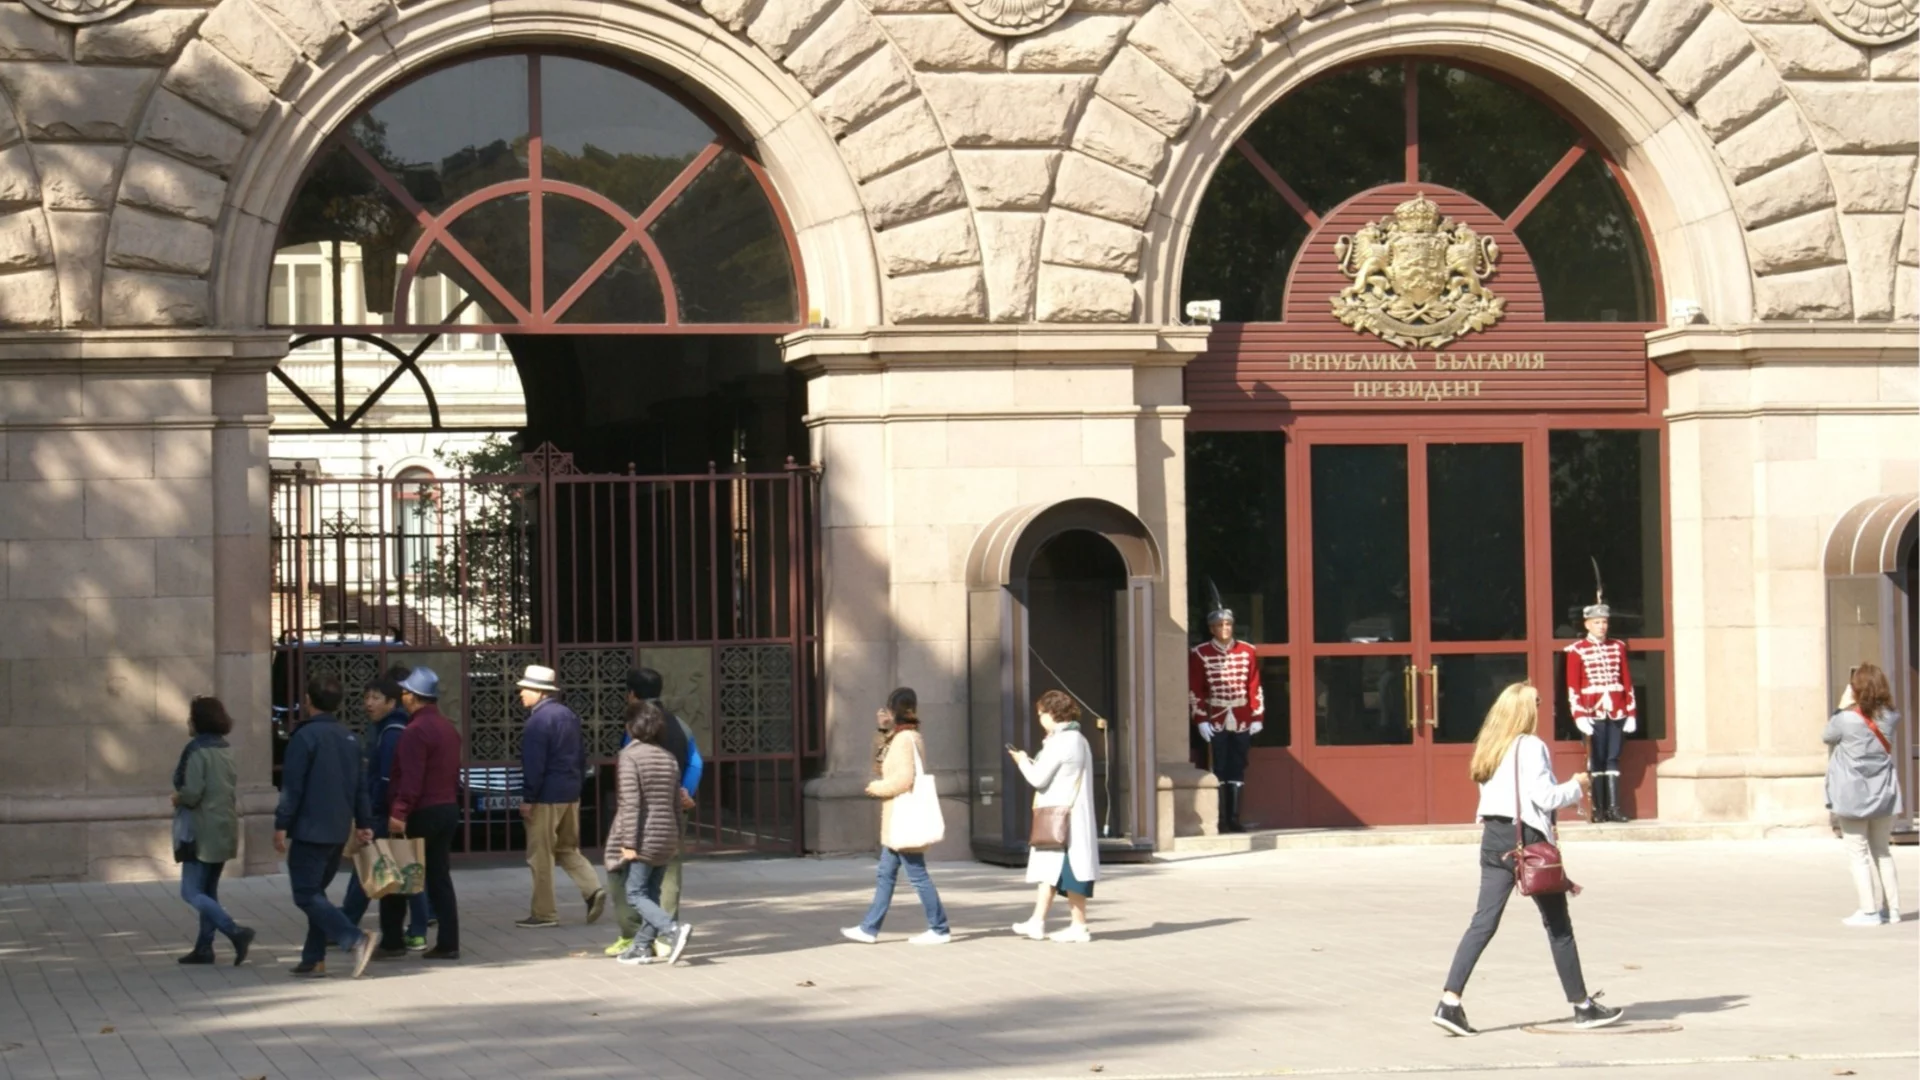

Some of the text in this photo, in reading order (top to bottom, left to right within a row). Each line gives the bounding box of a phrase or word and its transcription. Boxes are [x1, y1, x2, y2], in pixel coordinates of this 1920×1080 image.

[1289, 352, 1545, 370] РЕПУБЛИКА БЪЛГАРИЯ
[1353, 380, 1483, 401] ПРЕЗИДЕНТ
